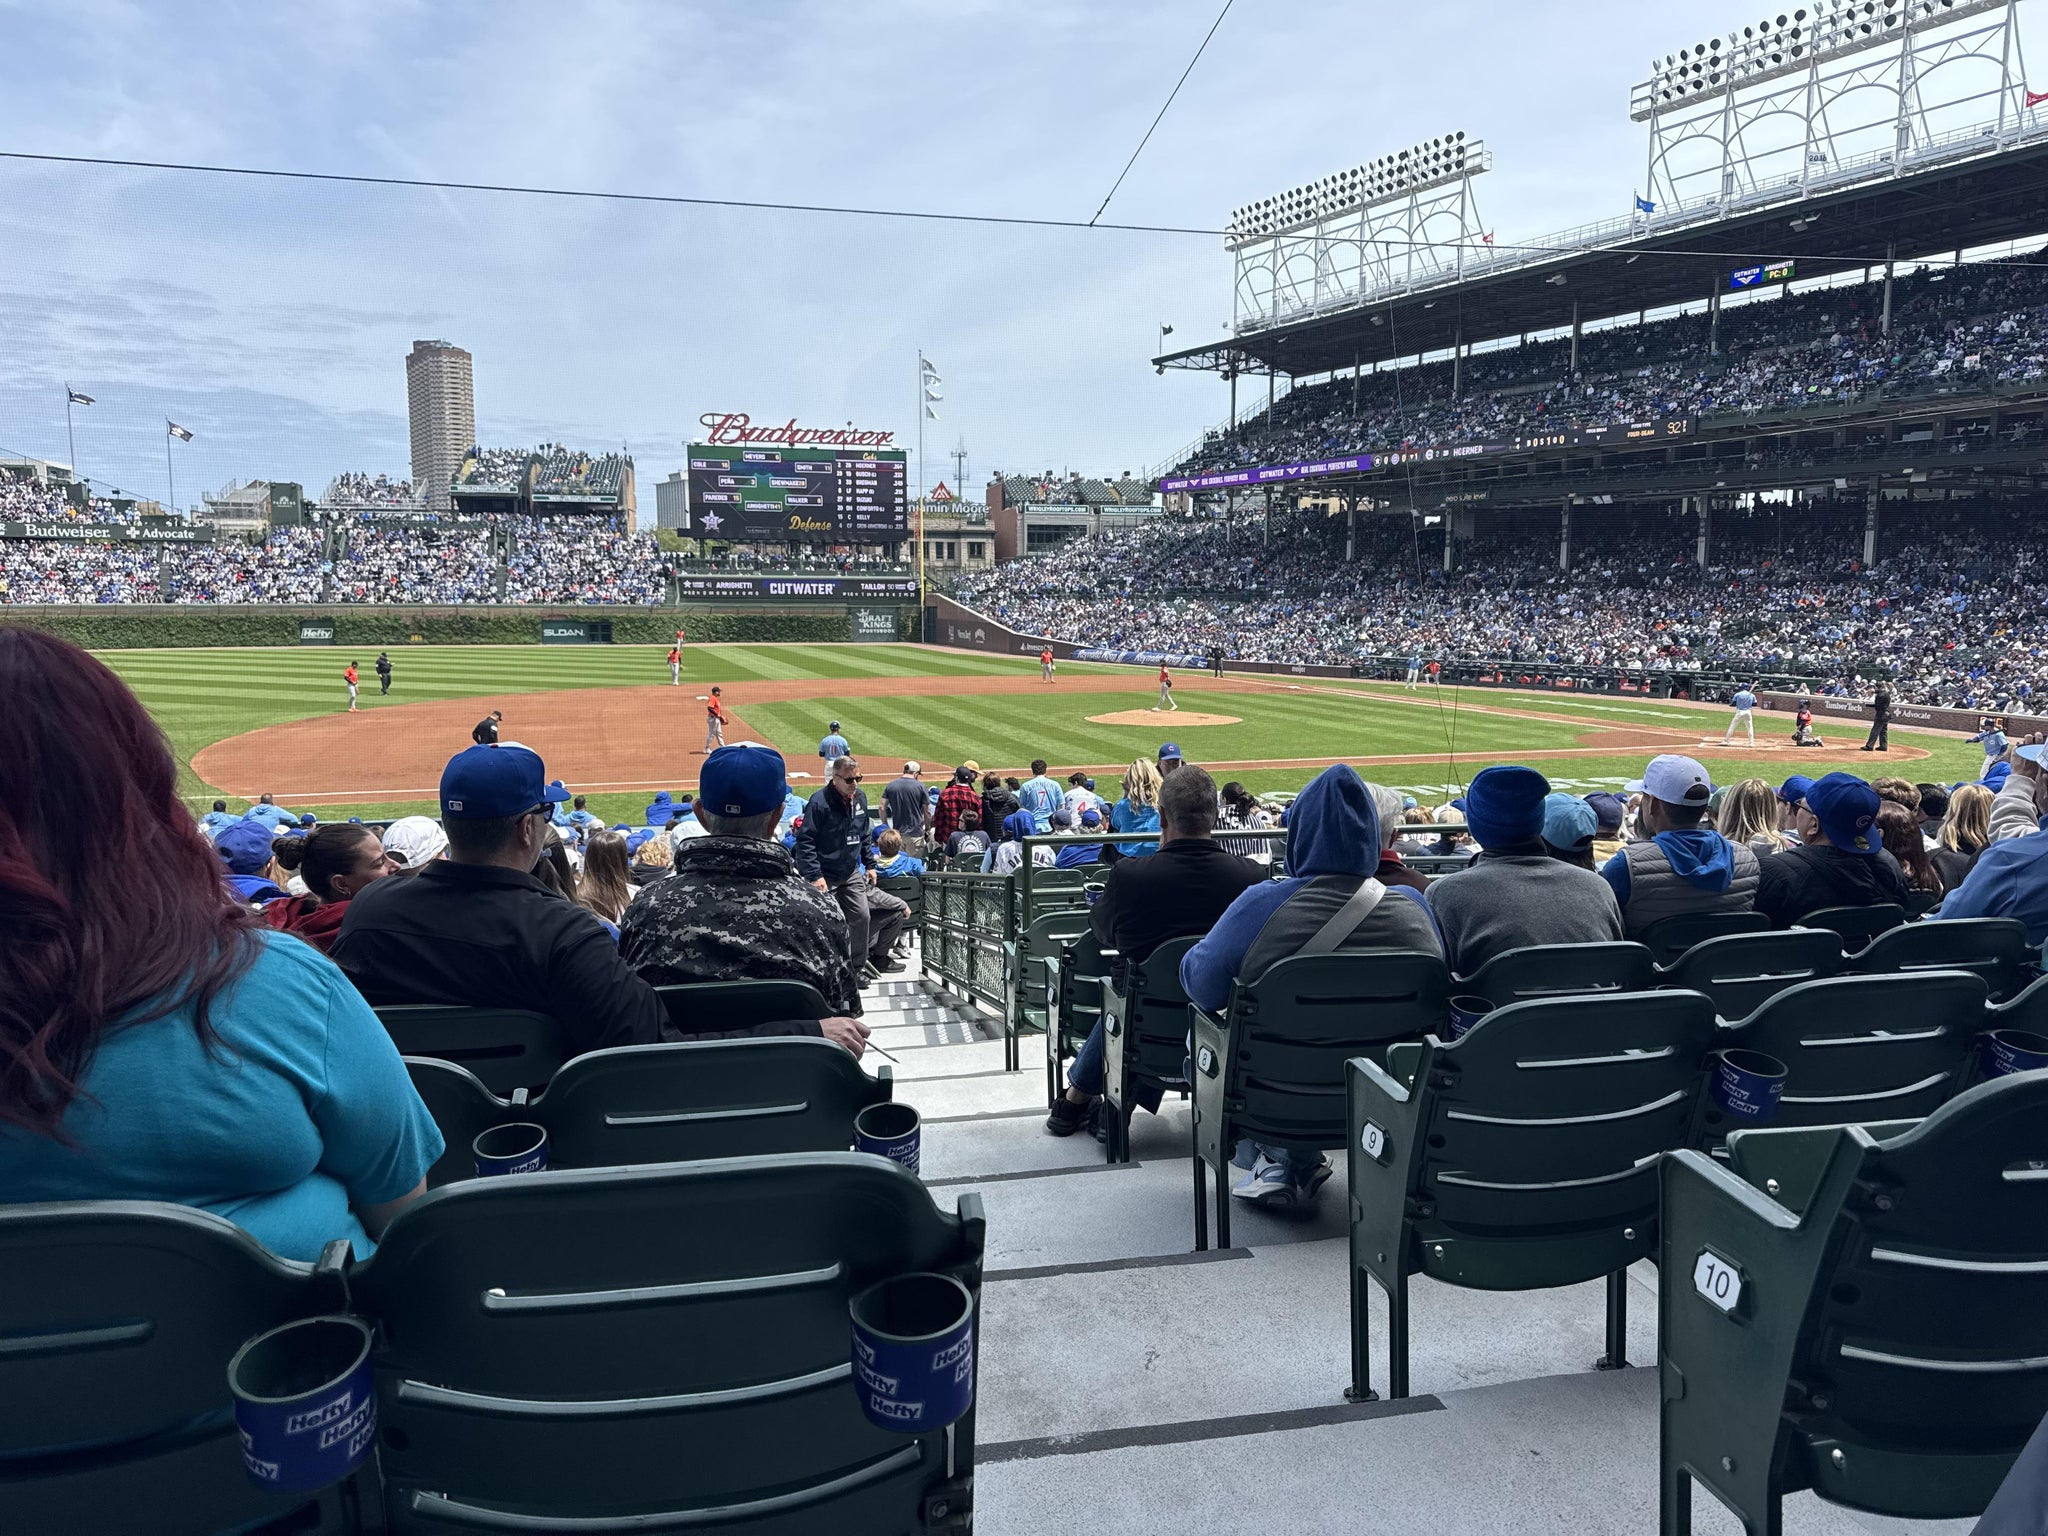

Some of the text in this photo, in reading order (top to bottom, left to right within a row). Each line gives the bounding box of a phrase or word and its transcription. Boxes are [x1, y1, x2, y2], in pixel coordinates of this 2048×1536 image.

[1734, 268, 1760, 278] CUTWATER
[1769, 268, 1788, 278] PC: 0
[700, 412, 894, 444] Budweiser
[1627, 429, 1655, 437] FOUR-SEAM
[1667, 421, 1681, 434] 92
[1533, 438, 1538, 447] 0
[1540, 438, 1544, 446] S
[1546, 437, 1550, 446] 1
[1559, 435, 1565, 445] 0
[1384, 456, 1388, 464] 0
[1453, 445, 1483, 457] HOERNER
[1260, 469, 1284, 478] CUTWATER
[1168, 480, 1188, 489] CUTWATER
[952, 503, 989, 513] Moore
[789, 516, 832, 532] Defense
[142, 528, 195, 539] Advocate
[770, 583, 833, 594] CUTWATER
[302, 629, 332, 638] Hefty
[1825, 700, 1863, 712] TimberTech
[1902, 710, 1932, 720] Advocate
[1038, 791, 1046, 806] 7
[1077, 801, 1086, 812] 4
[1202, 1052, 1208, 1066] 8
[1723, 1082, 1748, 1099] Hefty
[1729, 1100, 1758, 1113] Hefty
[1369, 1131, 1376, 1149] 9
[890, 1142, 915, 1156] Hefty
[511, 1160, 538, 1174] Hefty
[1707, 1263, 1730, 1298] 10
[860, 1364, 897, 1394] Hefty
[290, 1397, 350, 1431] Hefty
[873, 1398, 921, 1418] Hefty
[324, 1402, 368, 1445] Hefty
